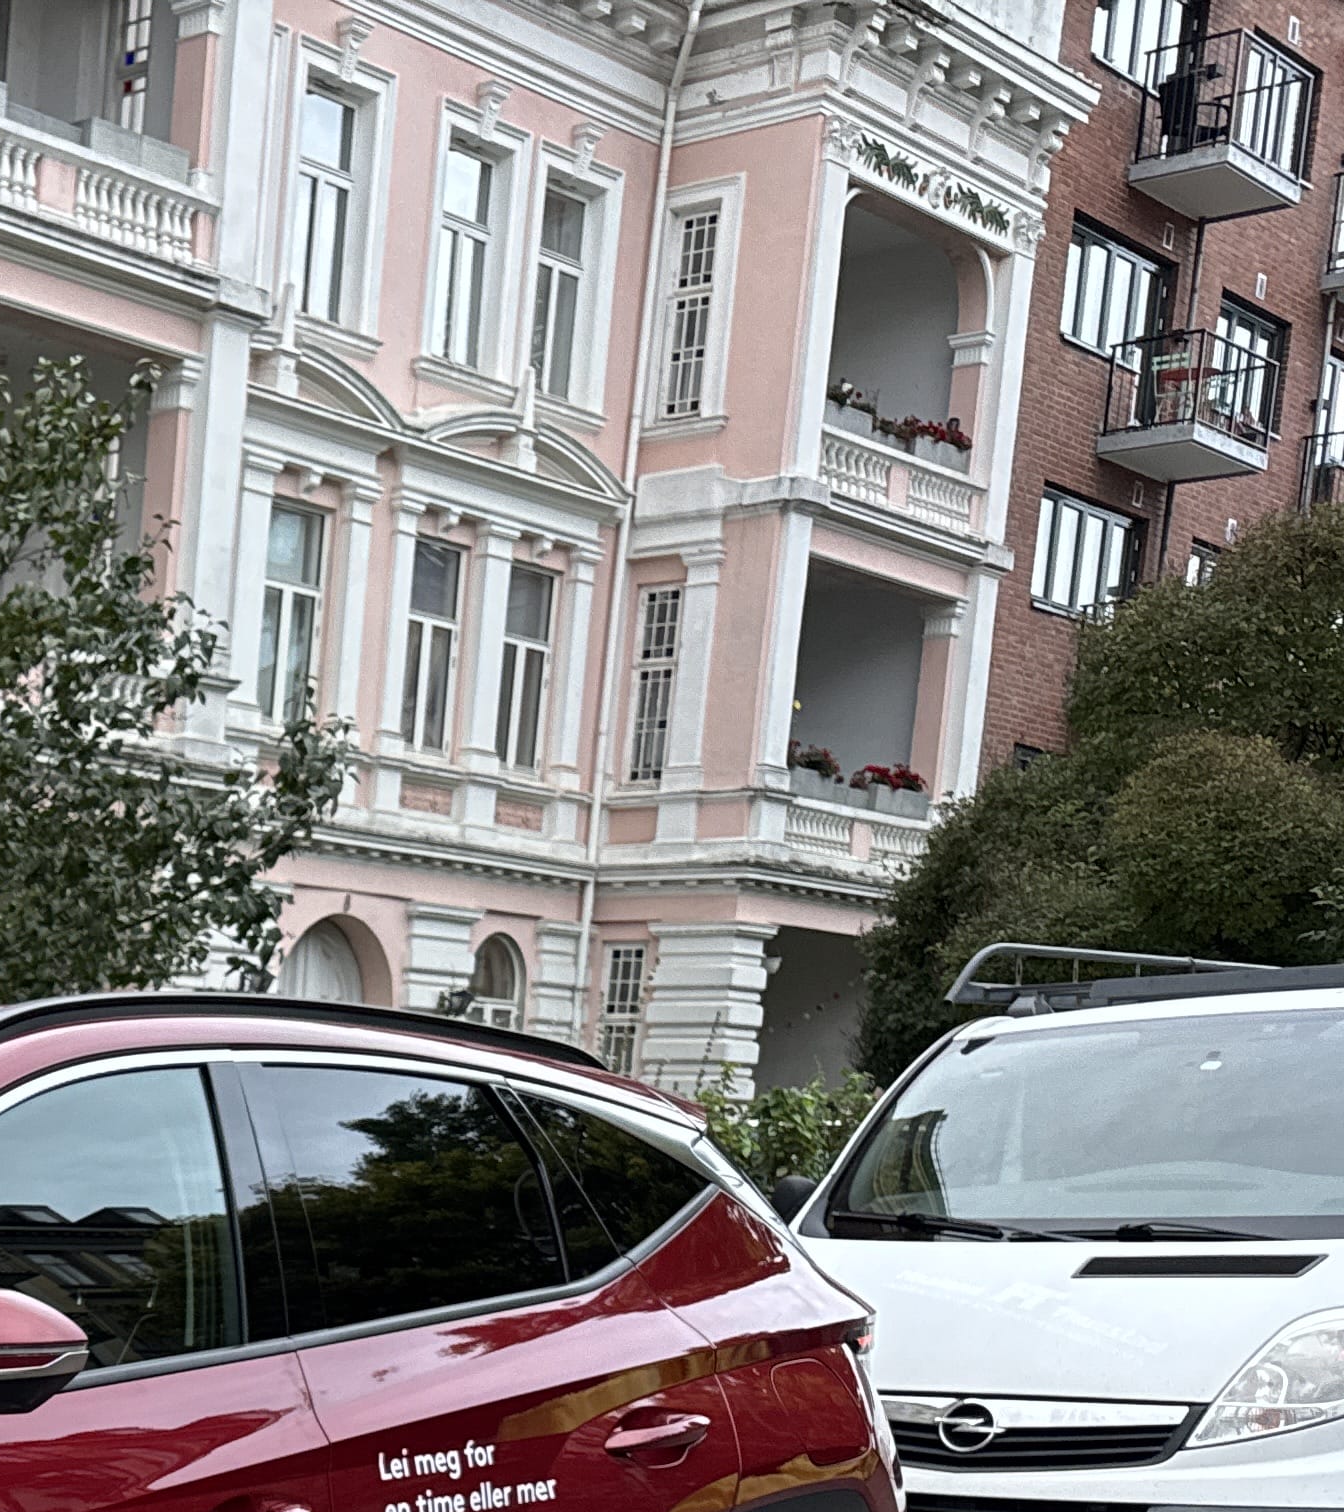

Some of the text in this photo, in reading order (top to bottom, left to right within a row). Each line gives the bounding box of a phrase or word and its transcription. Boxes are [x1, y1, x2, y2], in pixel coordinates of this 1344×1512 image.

[378, 1440, 495, 1481] Lei meg for
[470, 1481, 512, 1512] eller
[517, 1479, 557, 1504] mer
